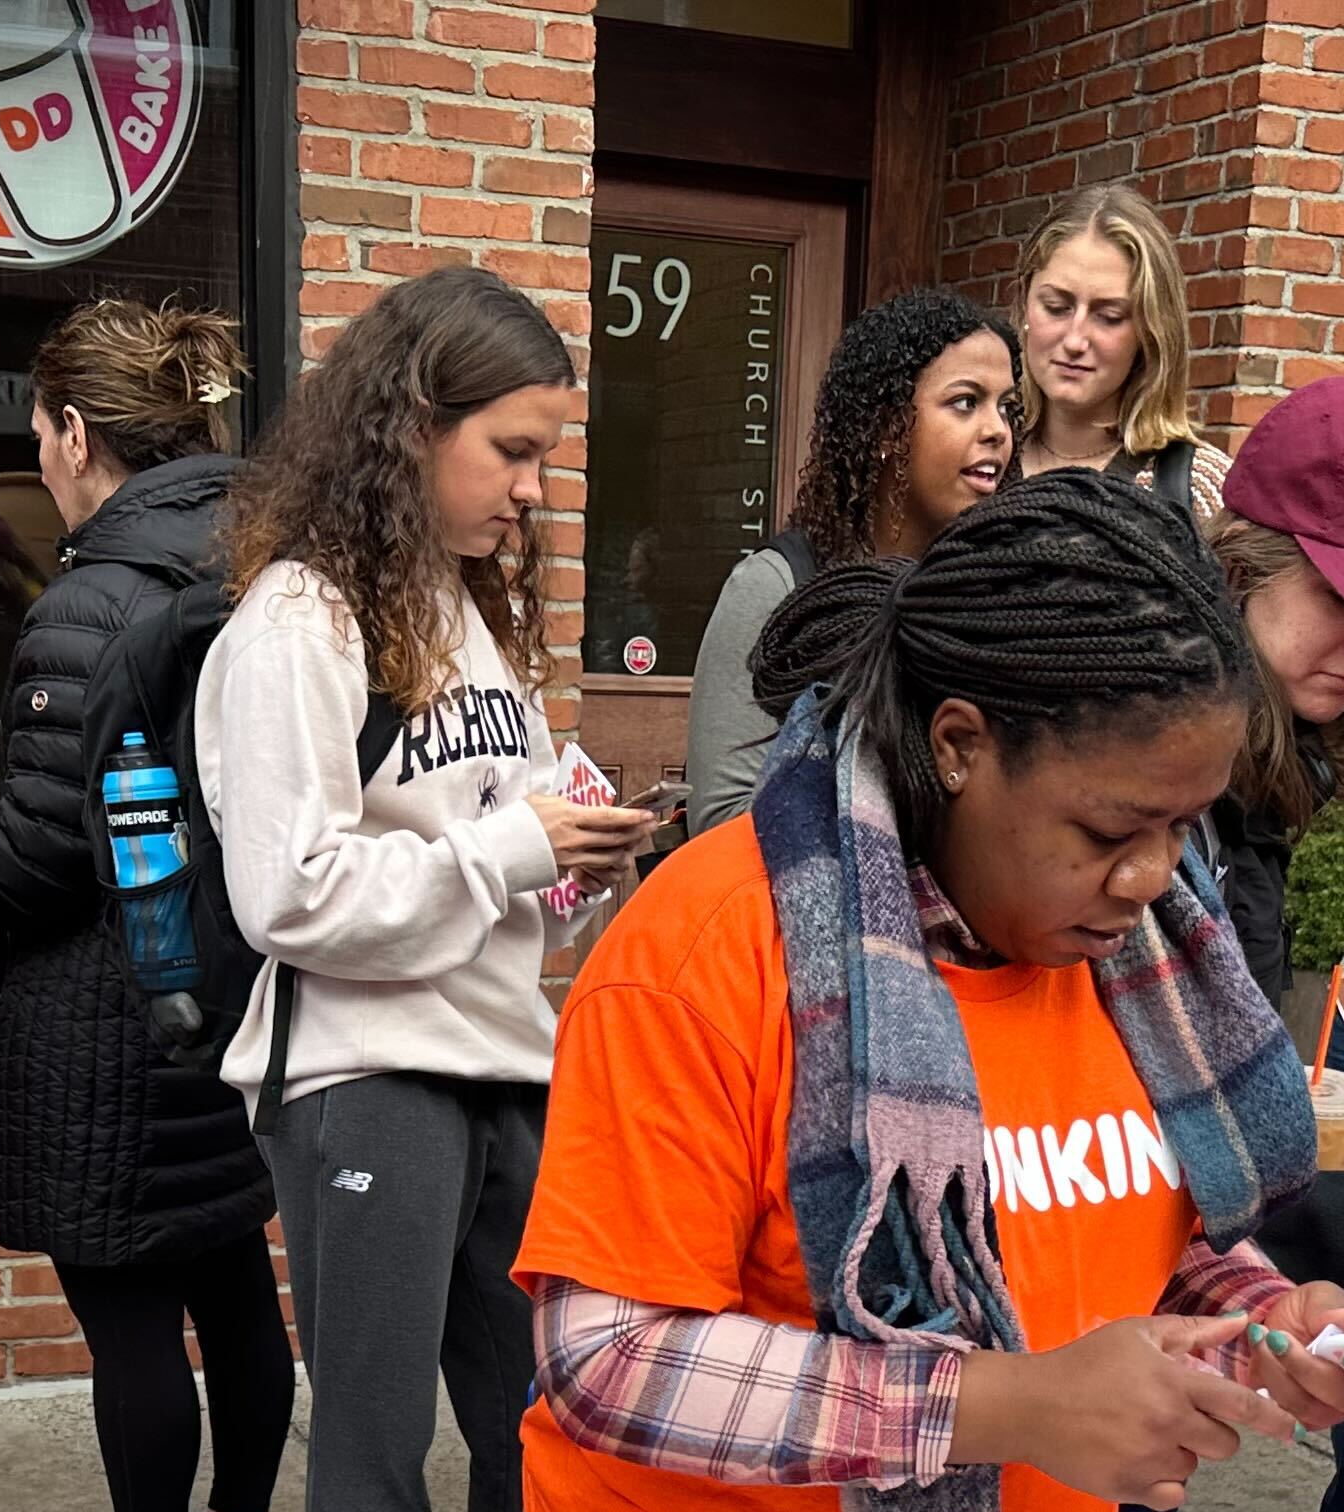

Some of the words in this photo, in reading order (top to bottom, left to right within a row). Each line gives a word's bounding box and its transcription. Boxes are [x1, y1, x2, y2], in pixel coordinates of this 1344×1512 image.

[119, 25, 172, 154] BAKE
[605, 253, 692, 342] 59
[744, 263, 773, 445] CHURCH
[740, 487, 765, 557] ST
